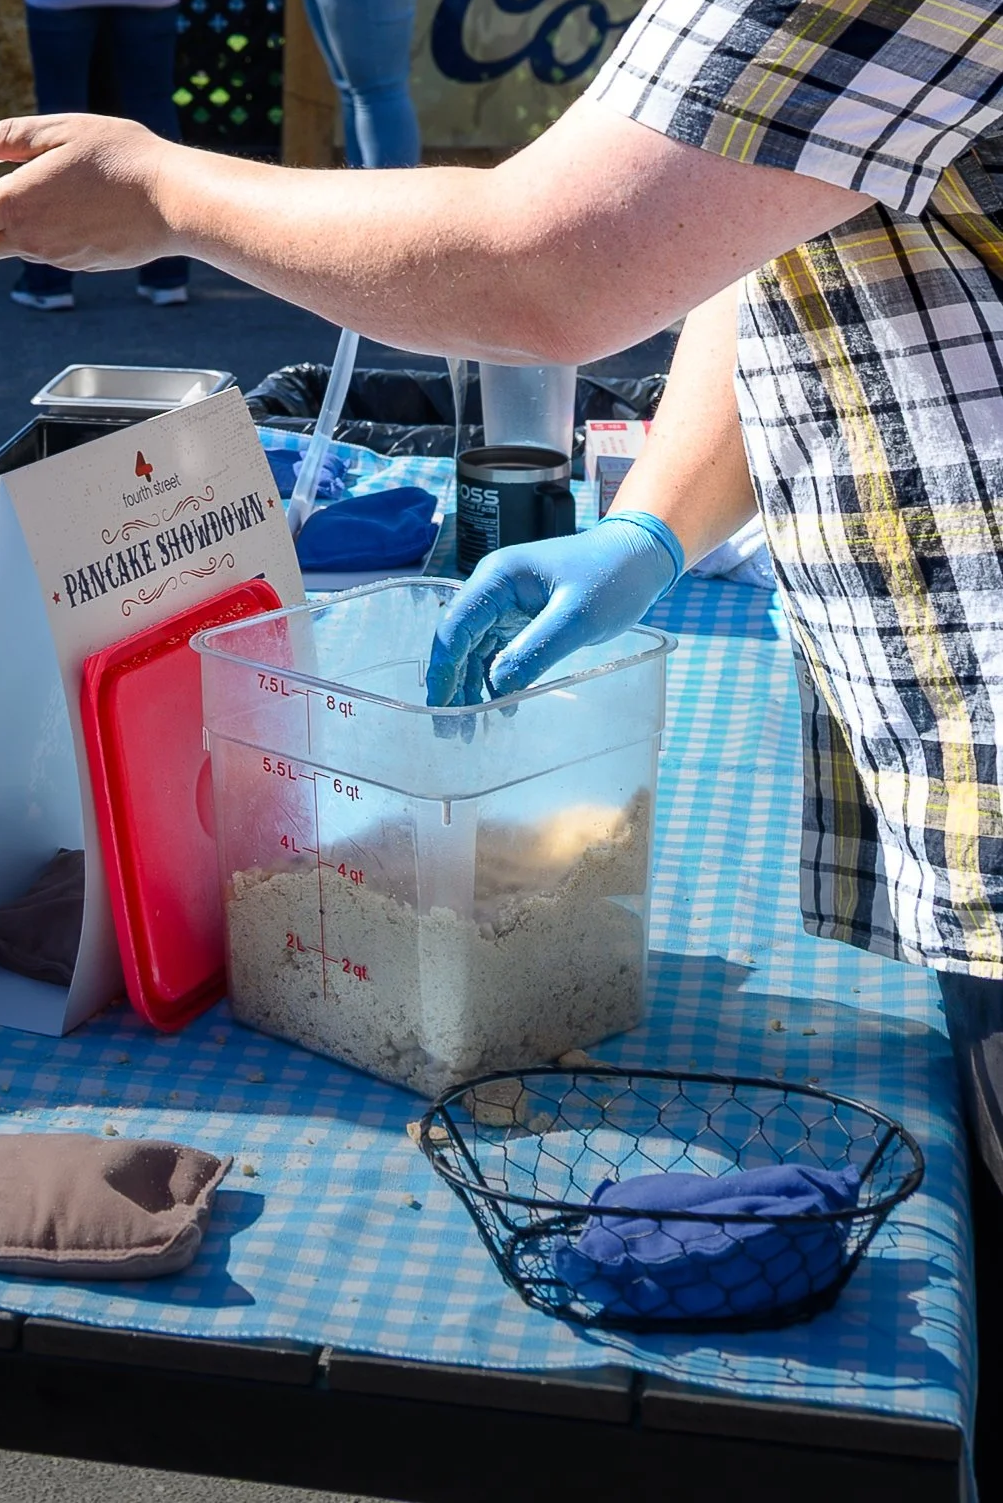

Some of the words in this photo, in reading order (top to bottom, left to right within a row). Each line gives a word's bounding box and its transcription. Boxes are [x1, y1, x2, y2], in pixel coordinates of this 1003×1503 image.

[123, 485, 154, 508] fourth
[153, 472, 182, 497] street
[458, 483, 499, 505] OSS
[63, 541, 157, 608] PANCAKE
[155, 491, 267, 566] SHOWDOWN
[326, 695, 336, 711] 8
[339, 701, 356, 718] qt.
[333, 778, 343, 794] 6
[346, 785, 363, 802] qt.
[280, 835, 289, 850] 4
[337, 863, 347, 878] 4
[286, 933, 295, 948] 2
[342, 958, 351, 974] 2
